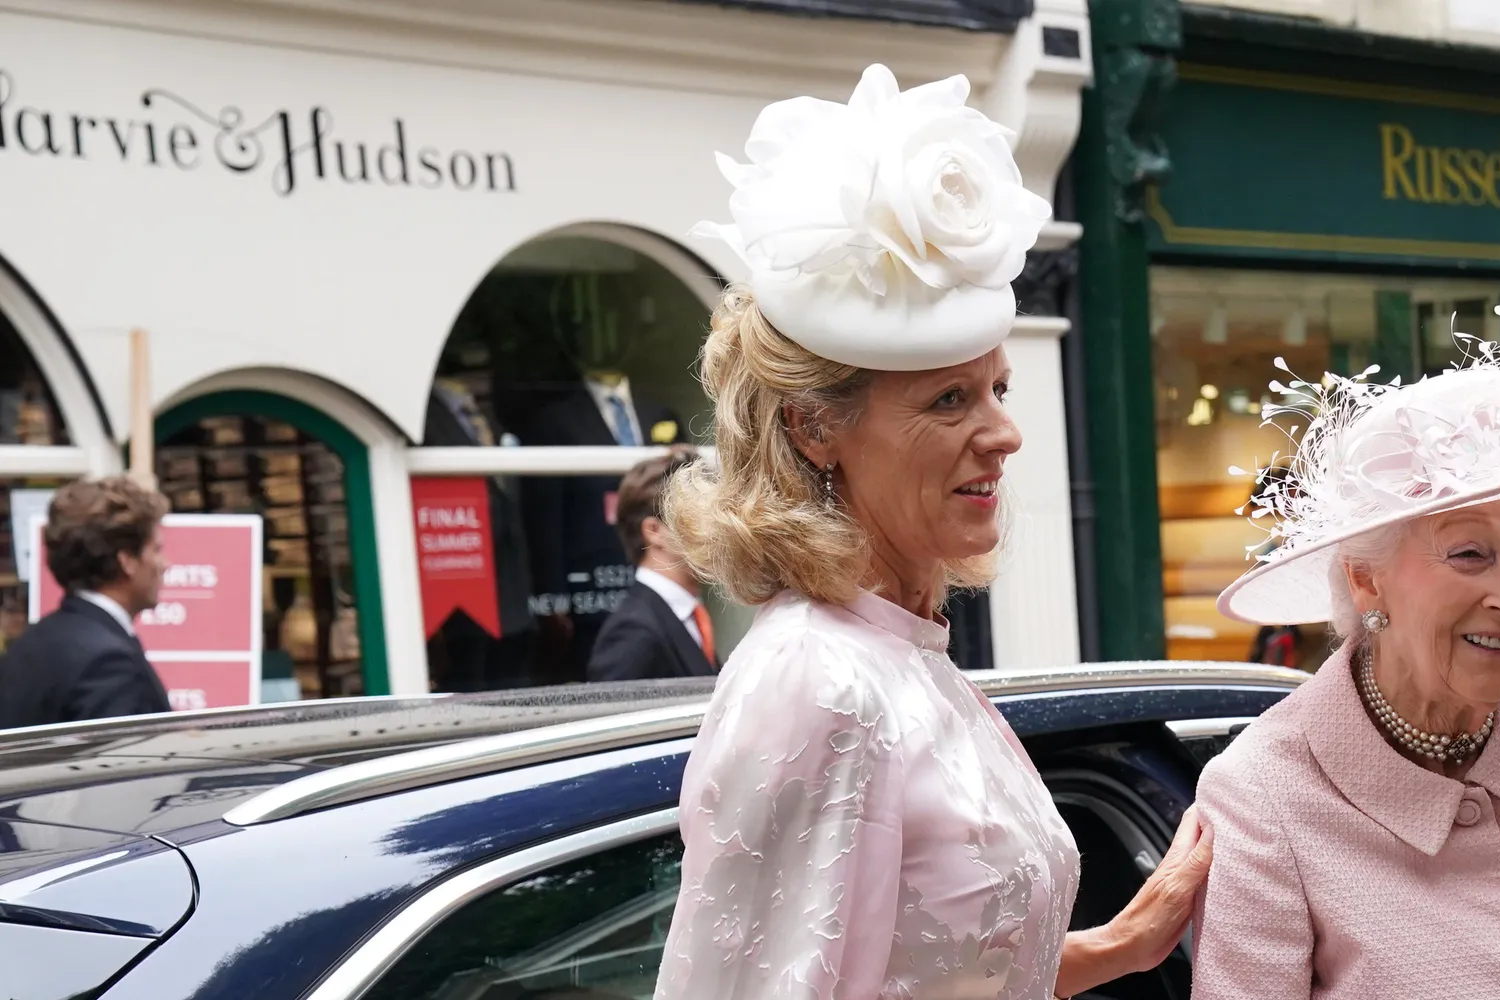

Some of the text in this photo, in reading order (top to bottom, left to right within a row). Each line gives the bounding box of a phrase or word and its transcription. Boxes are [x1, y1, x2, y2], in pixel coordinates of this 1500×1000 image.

[271, 106, 518, 197] Hudson
[417, 505, 482, 529] FINAL
[527, 589, 628, 617] NEW SEAS
